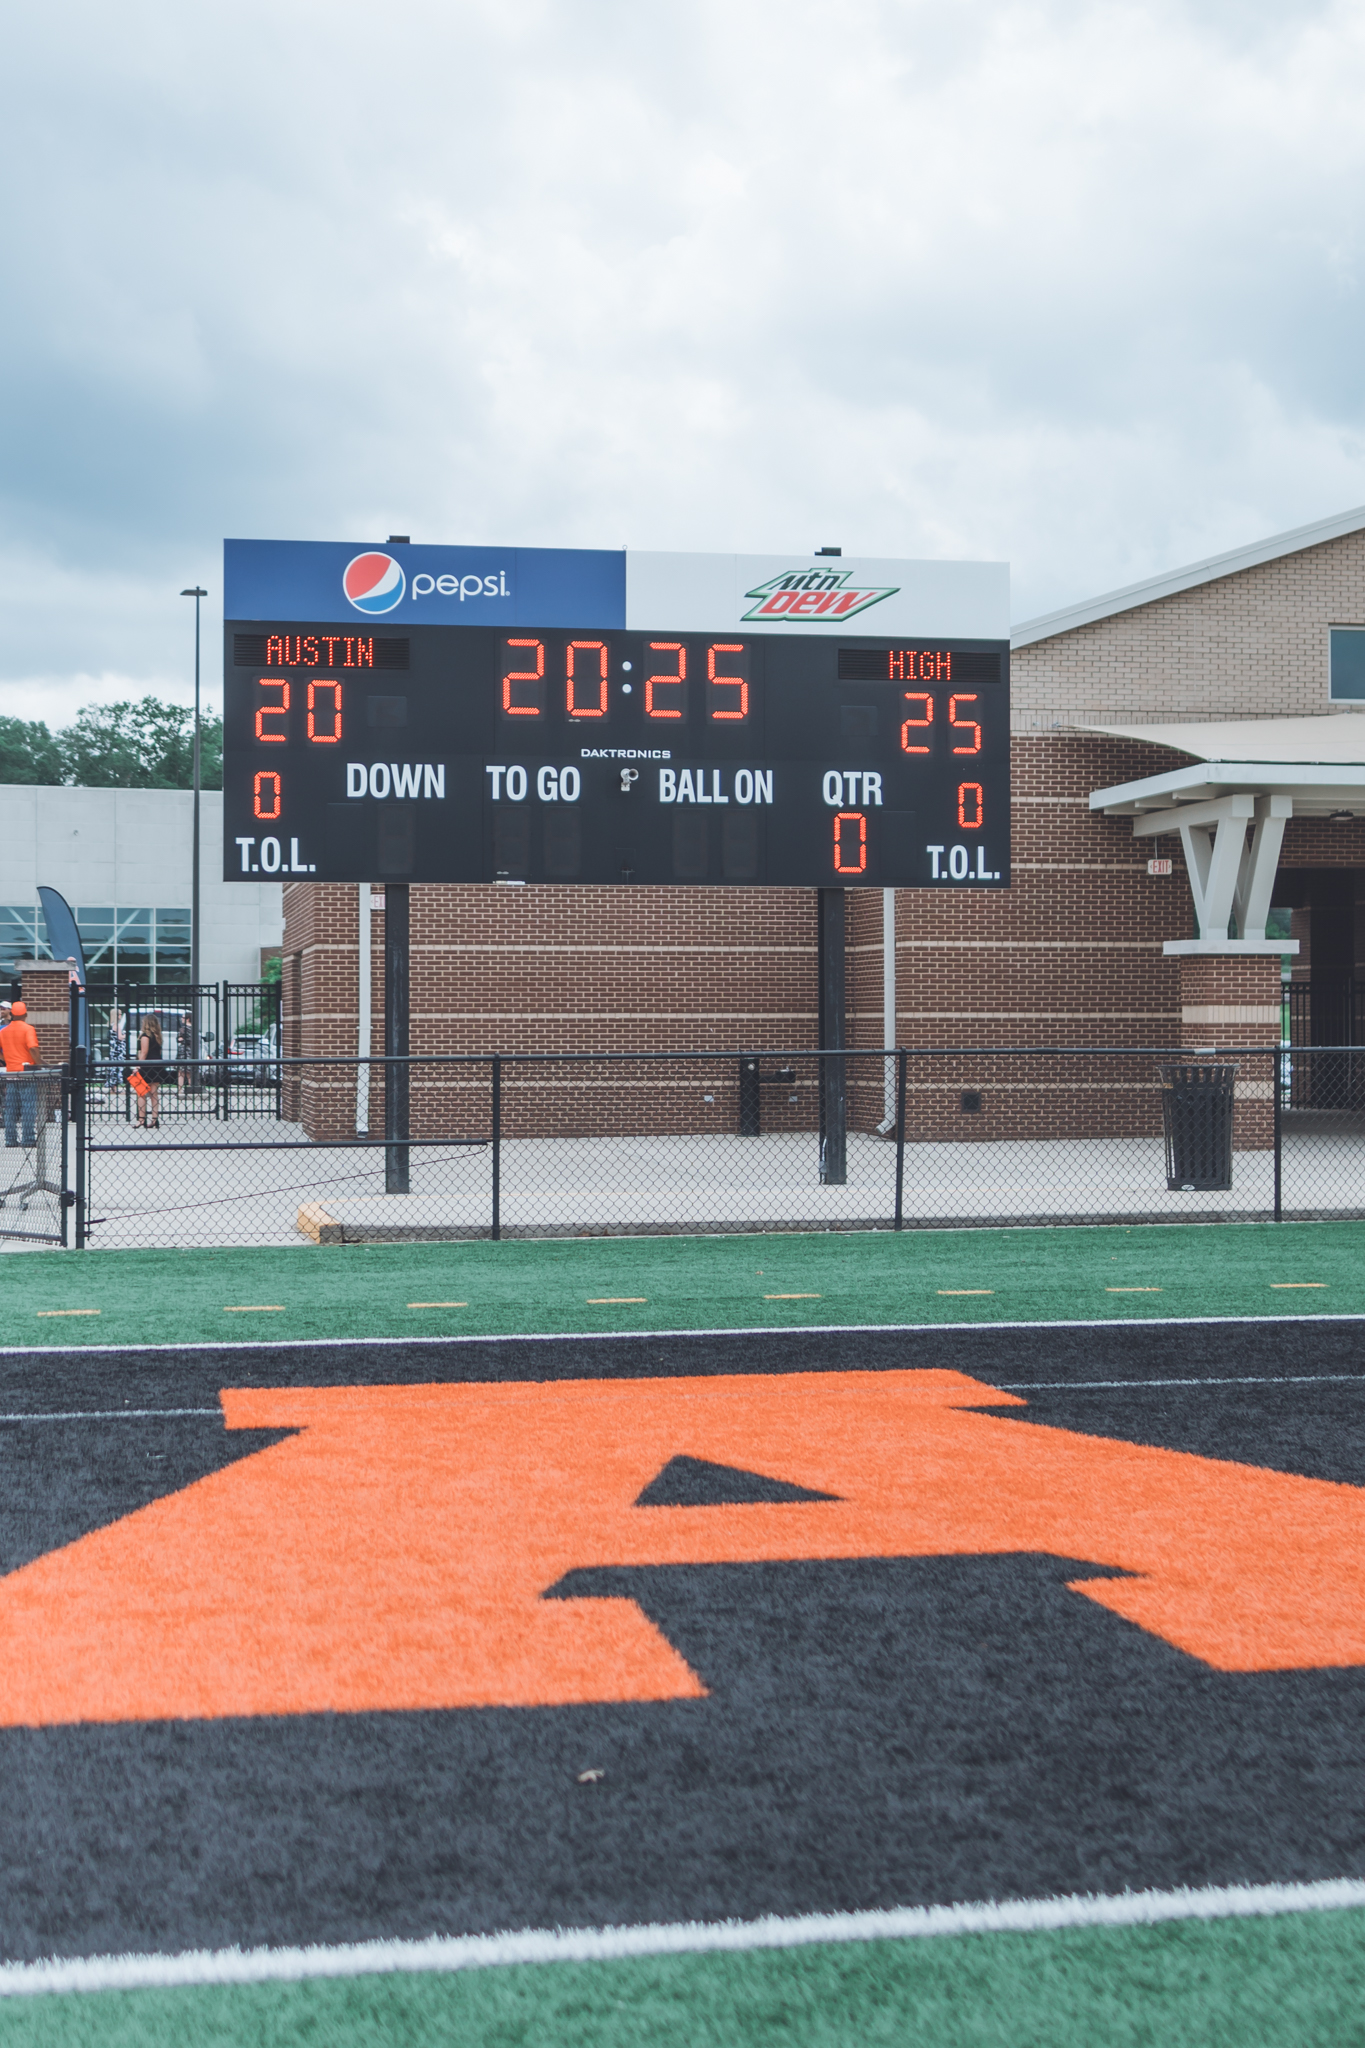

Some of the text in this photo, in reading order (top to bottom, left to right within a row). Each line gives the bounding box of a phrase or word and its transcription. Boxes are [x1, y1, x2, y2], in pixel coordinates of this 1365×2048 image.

[413, 571, 510, 601] pepsi
[267, 636, 373, 667] AUSTIN
[889, 651, 951, 680] HIGH
[503, 639, 748, 719] 20:25
[255, 679, 342, 743] 20
[901, 692, 981, 754] 25
[581, 748, 671, 759] DAKTRONICS
[254, 771, 281, 819] 0
[347, 763, 444, 798] DOWN
[486, 766, 580, 801] TO GO
[660, 769, 772, 803] BALL ON
[823, 771, 882, 807] QTR
[958, 783, 983, 828] 0
[236, 837, 315, 872] T.O.L.
[834, 813, 866, 873] 0
[927, 845, 999, 879] T.O.L.
[1152, 860, 1169, 873] EXIT
